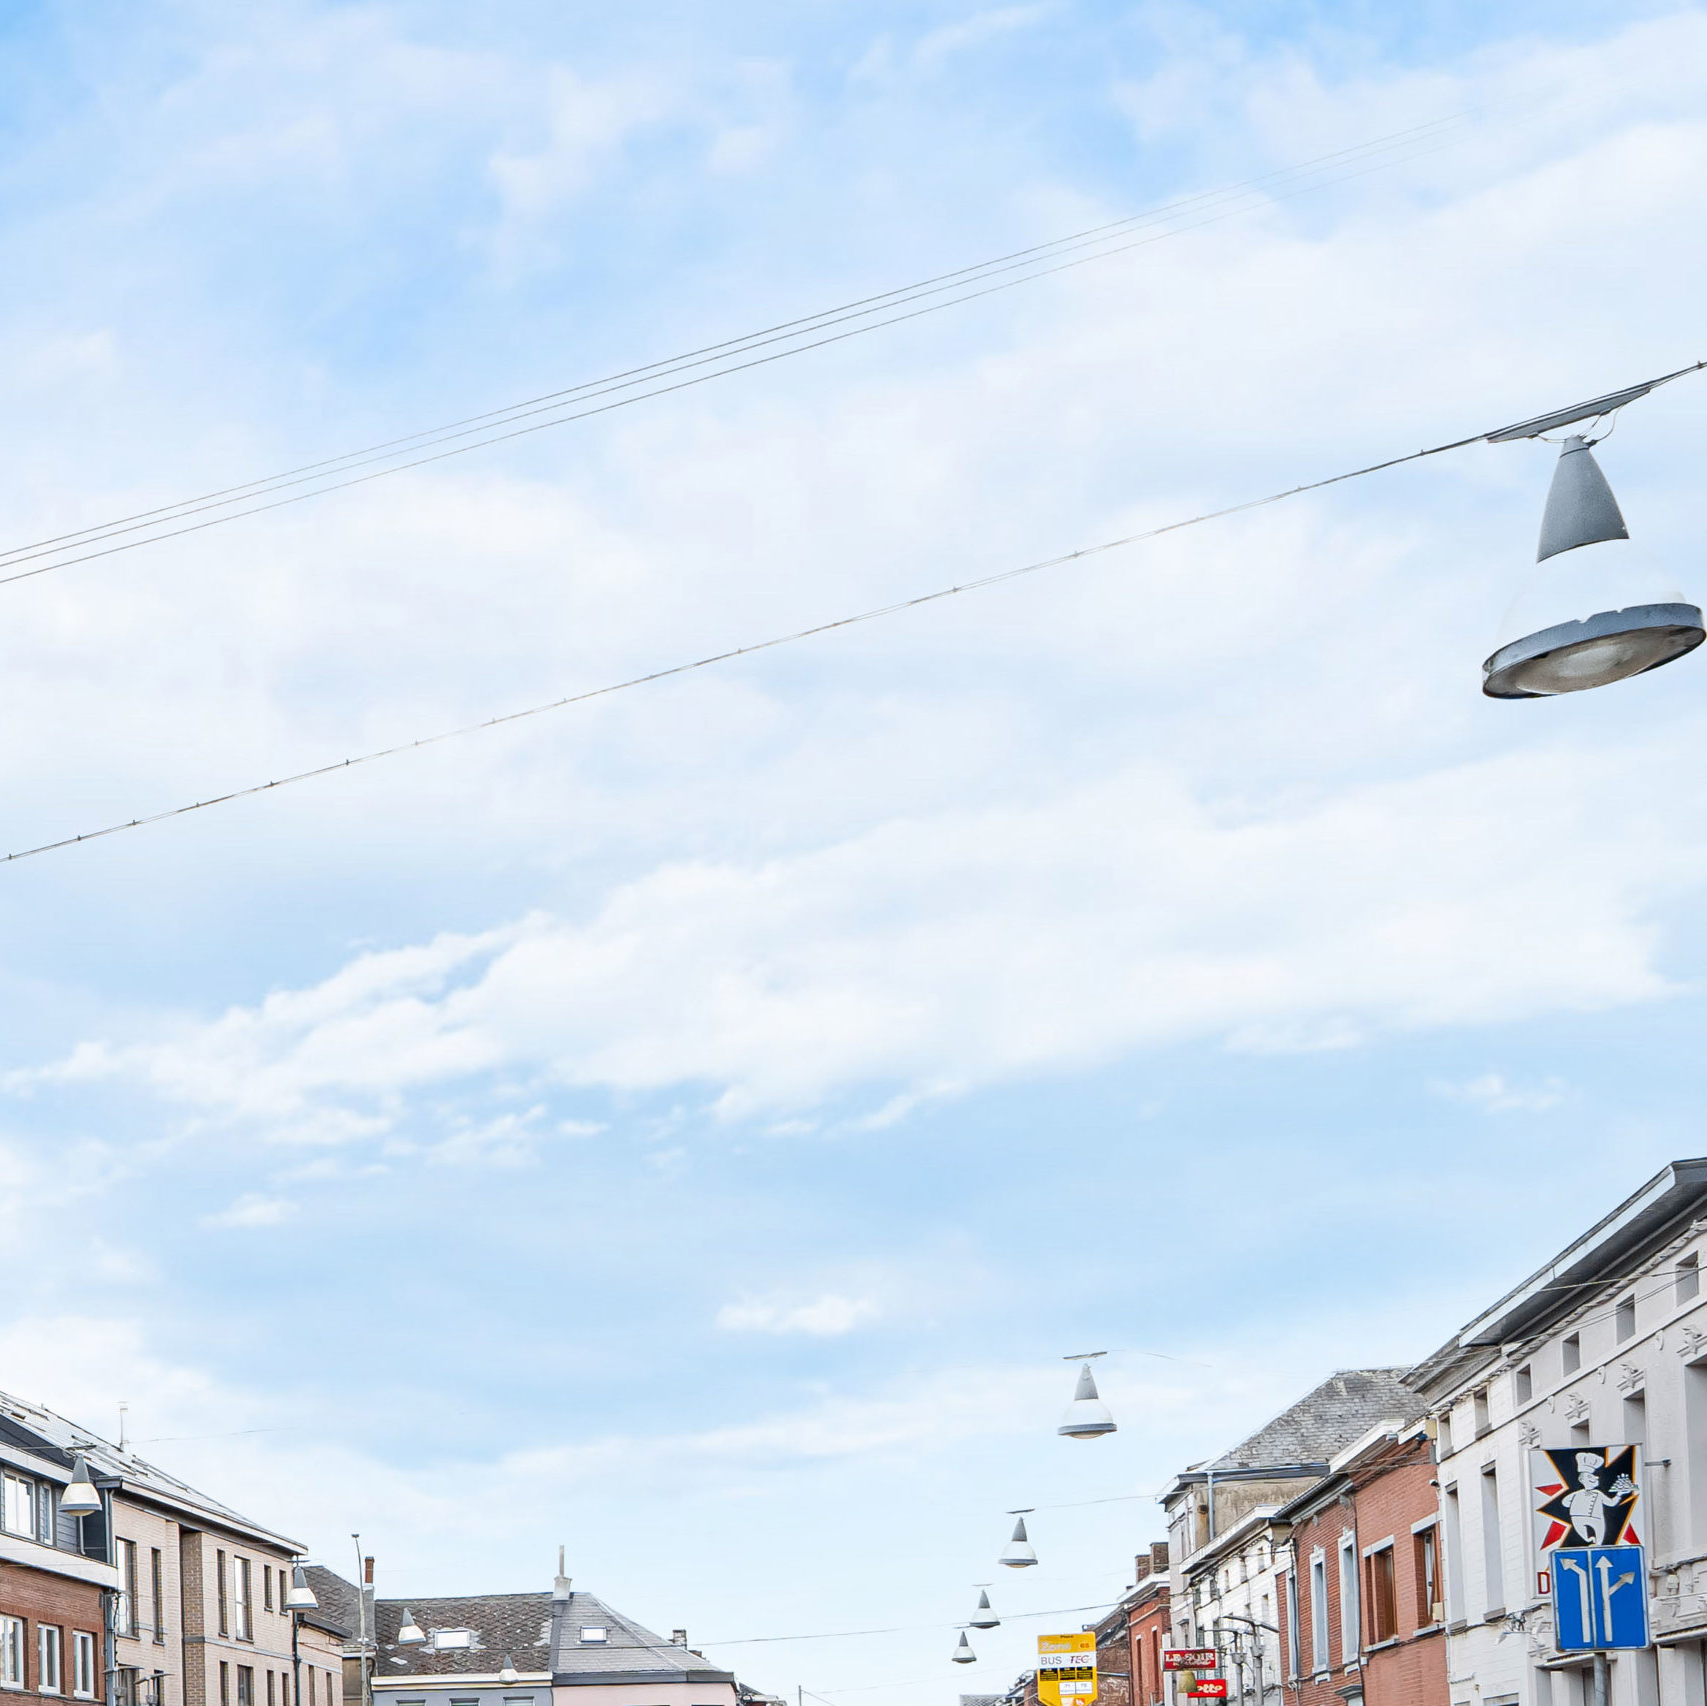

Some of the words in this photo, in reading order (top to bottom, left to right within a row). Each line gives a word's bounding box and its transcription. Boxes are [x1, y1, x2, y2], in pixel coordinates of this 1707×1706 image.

[1040, 1656, 1062, 1665] BUS
[1070, 1655, 1089, 1663] TEC
[1184, 1652, 1215, 1662] SOIR
